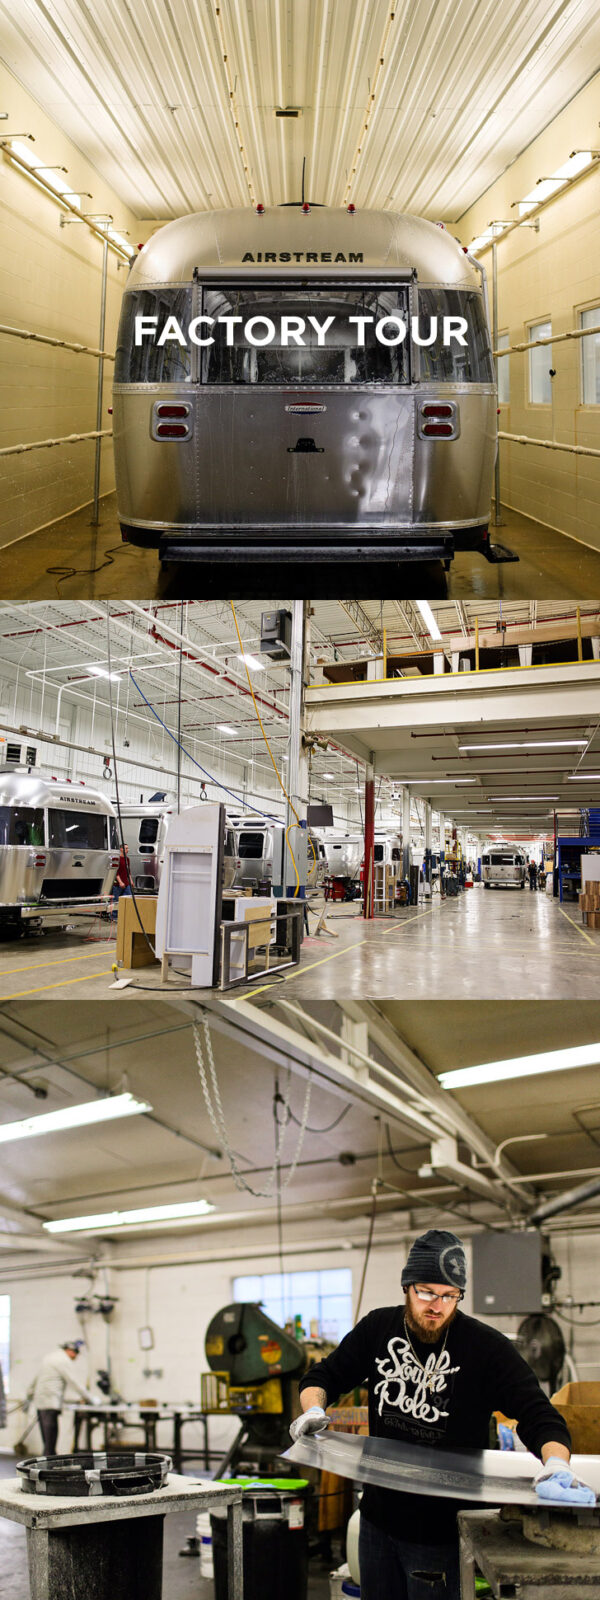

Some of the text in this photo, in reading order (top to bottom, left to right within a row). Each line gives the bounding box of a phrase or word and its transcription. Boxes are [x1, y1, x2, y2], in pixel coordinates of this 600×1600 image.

[241, 252, 364, 263] AIRSTREAM
[60, 796, 95, 805] AIRSTREAM
[374, 1378, 449, 1422] Pole
